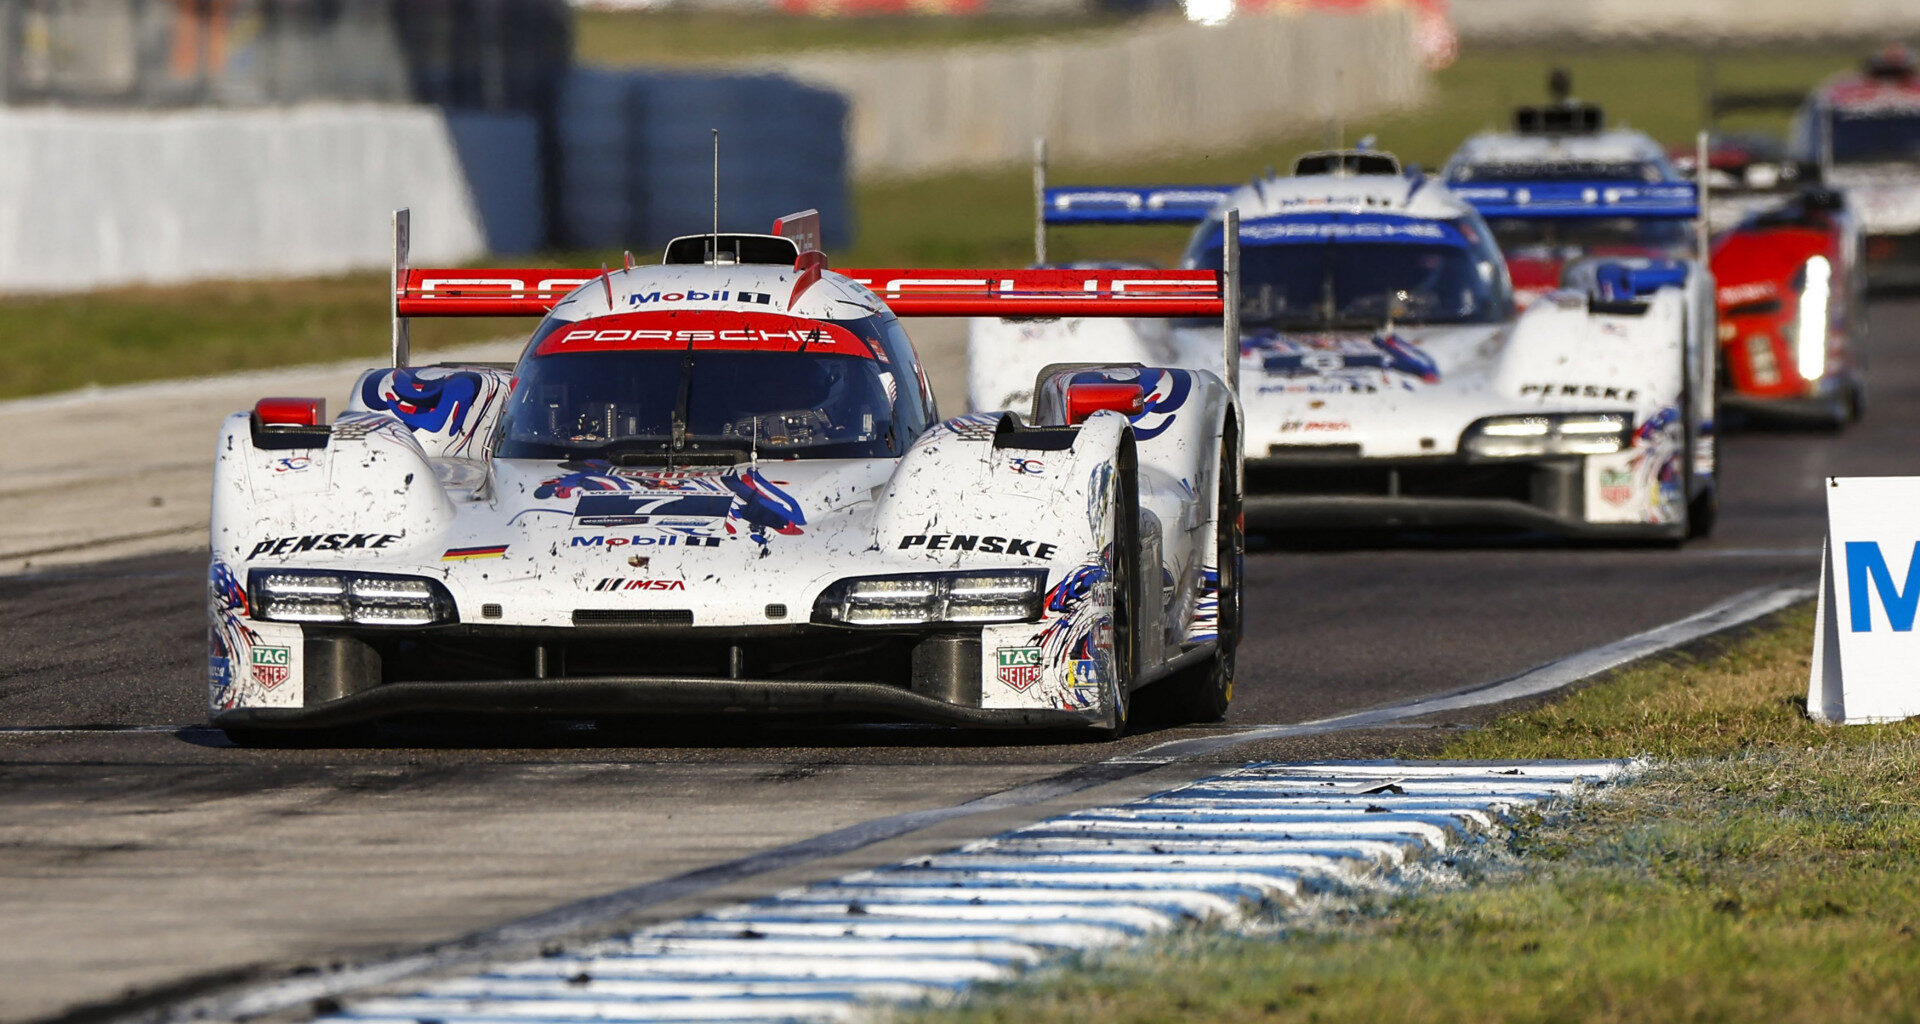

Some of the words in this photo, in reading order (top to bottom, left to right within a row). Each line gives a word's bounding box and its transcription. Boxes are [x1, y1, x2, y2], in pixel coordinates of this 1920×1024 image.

[629, 290, 730, 306] Mobil
[561, 329, 836, 345] PORSCHE
[1521, 383, 1639, 401] PENSKE
[628, 495, 685, 515] 7
[246, 533, 402, 562] PENSKE
[570, 535, 677, 547] Mobil
[898, 534, 1058, 561] PENSKE
[624, 579, 686, 591] IMSA
[254, 649, 286, 664] TAG
[1001, 650, 1038, 665] TAG
[253, 666, 288, 687] HEUER
[1000, 666, 1040, 688] HEUER
